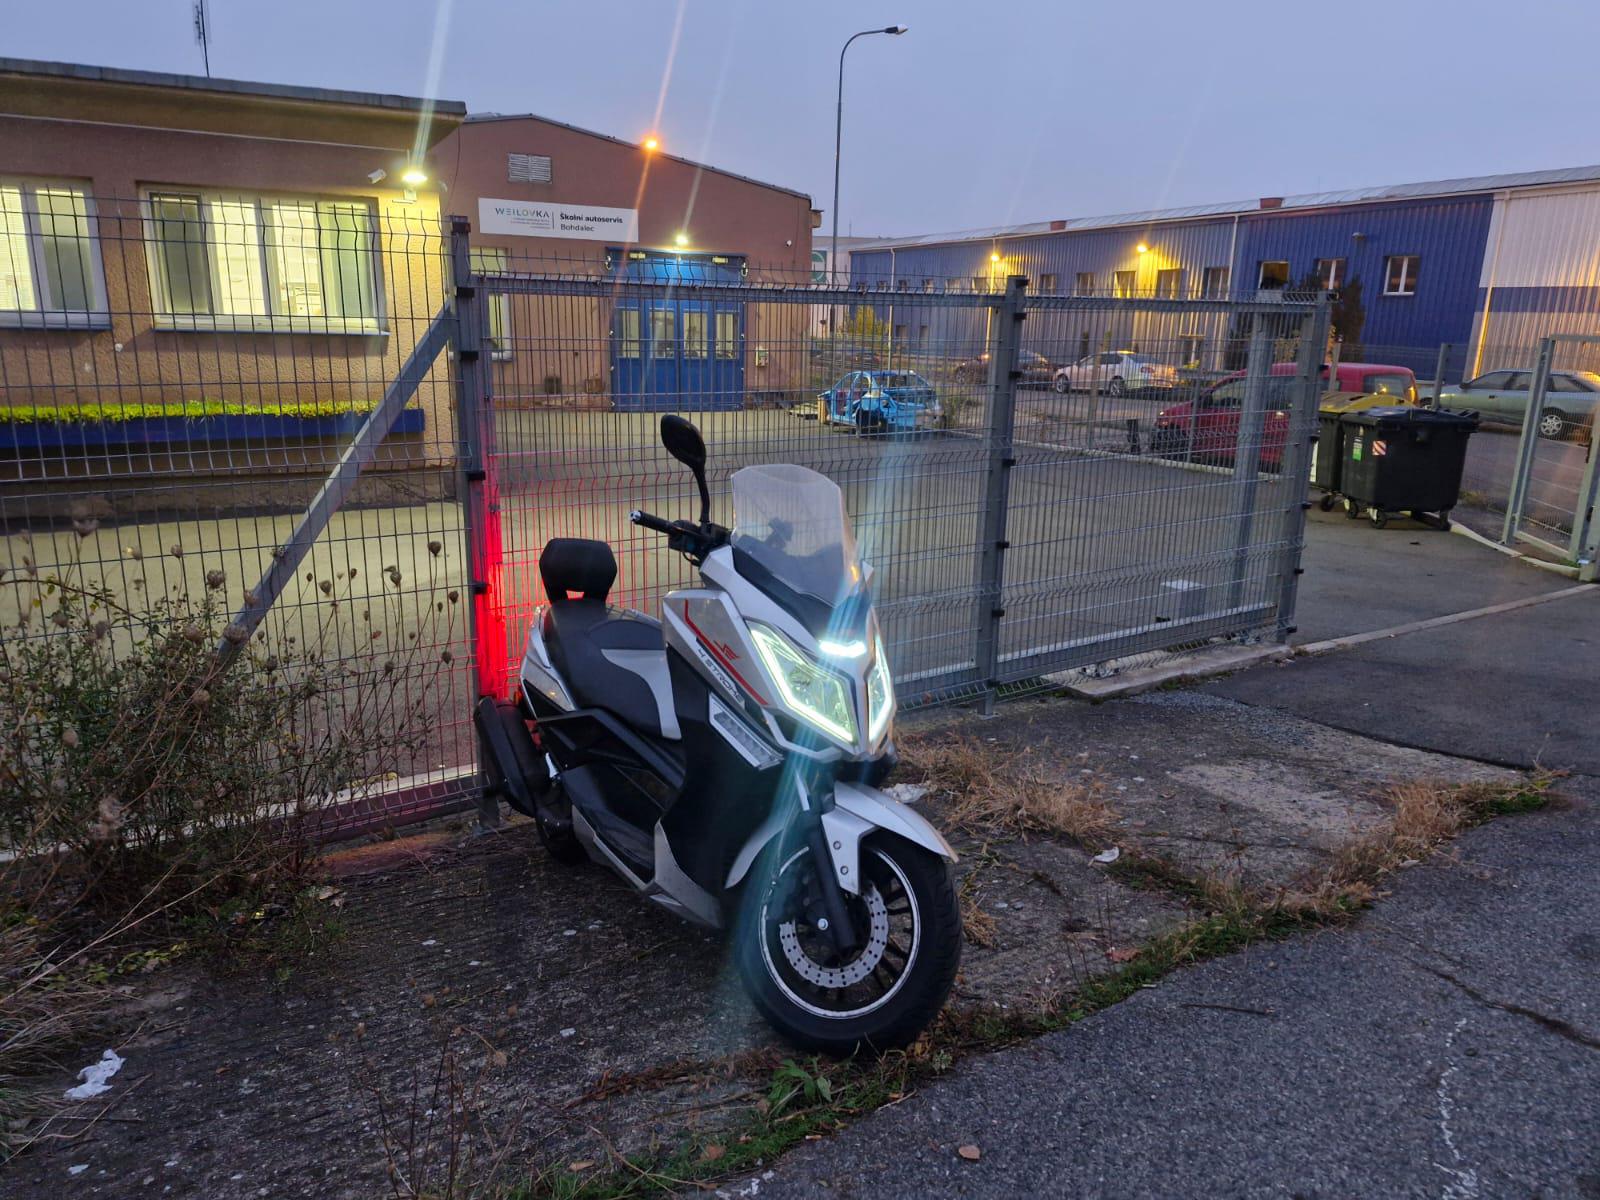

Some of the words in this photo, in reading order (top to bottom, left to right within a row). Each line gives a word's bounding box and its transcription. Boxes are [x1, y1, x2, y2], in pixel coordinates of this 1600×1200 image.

[560, 212, 584, 221] Školní
[585, 215, 623, 224] autoservis
[560, 223, 594, 232] Bohdalec
[705, 659, 743, 703] STROKE
